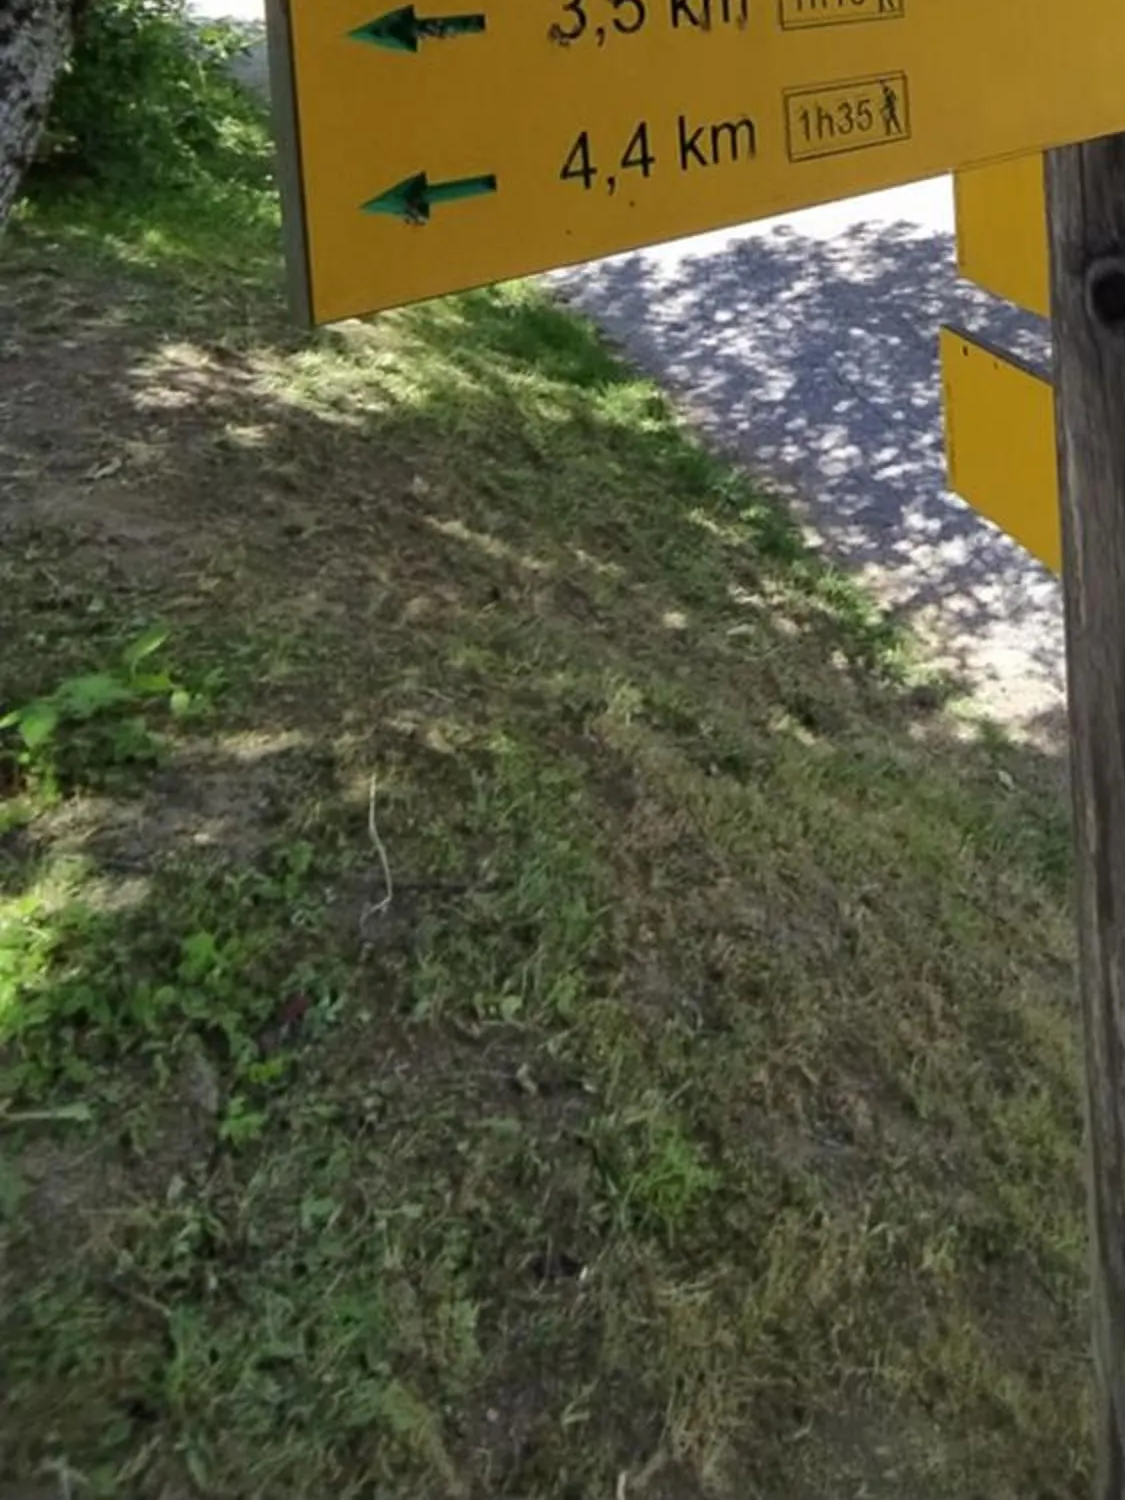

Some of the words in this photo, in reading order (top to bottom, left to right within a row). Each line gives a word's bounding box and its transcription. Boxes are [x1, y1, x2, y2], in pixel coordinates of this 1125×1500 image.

[799, 100, 874, 142] 1h35
[559, 121, 656, 196] 4,4
[678, 114, 757, 172] km
